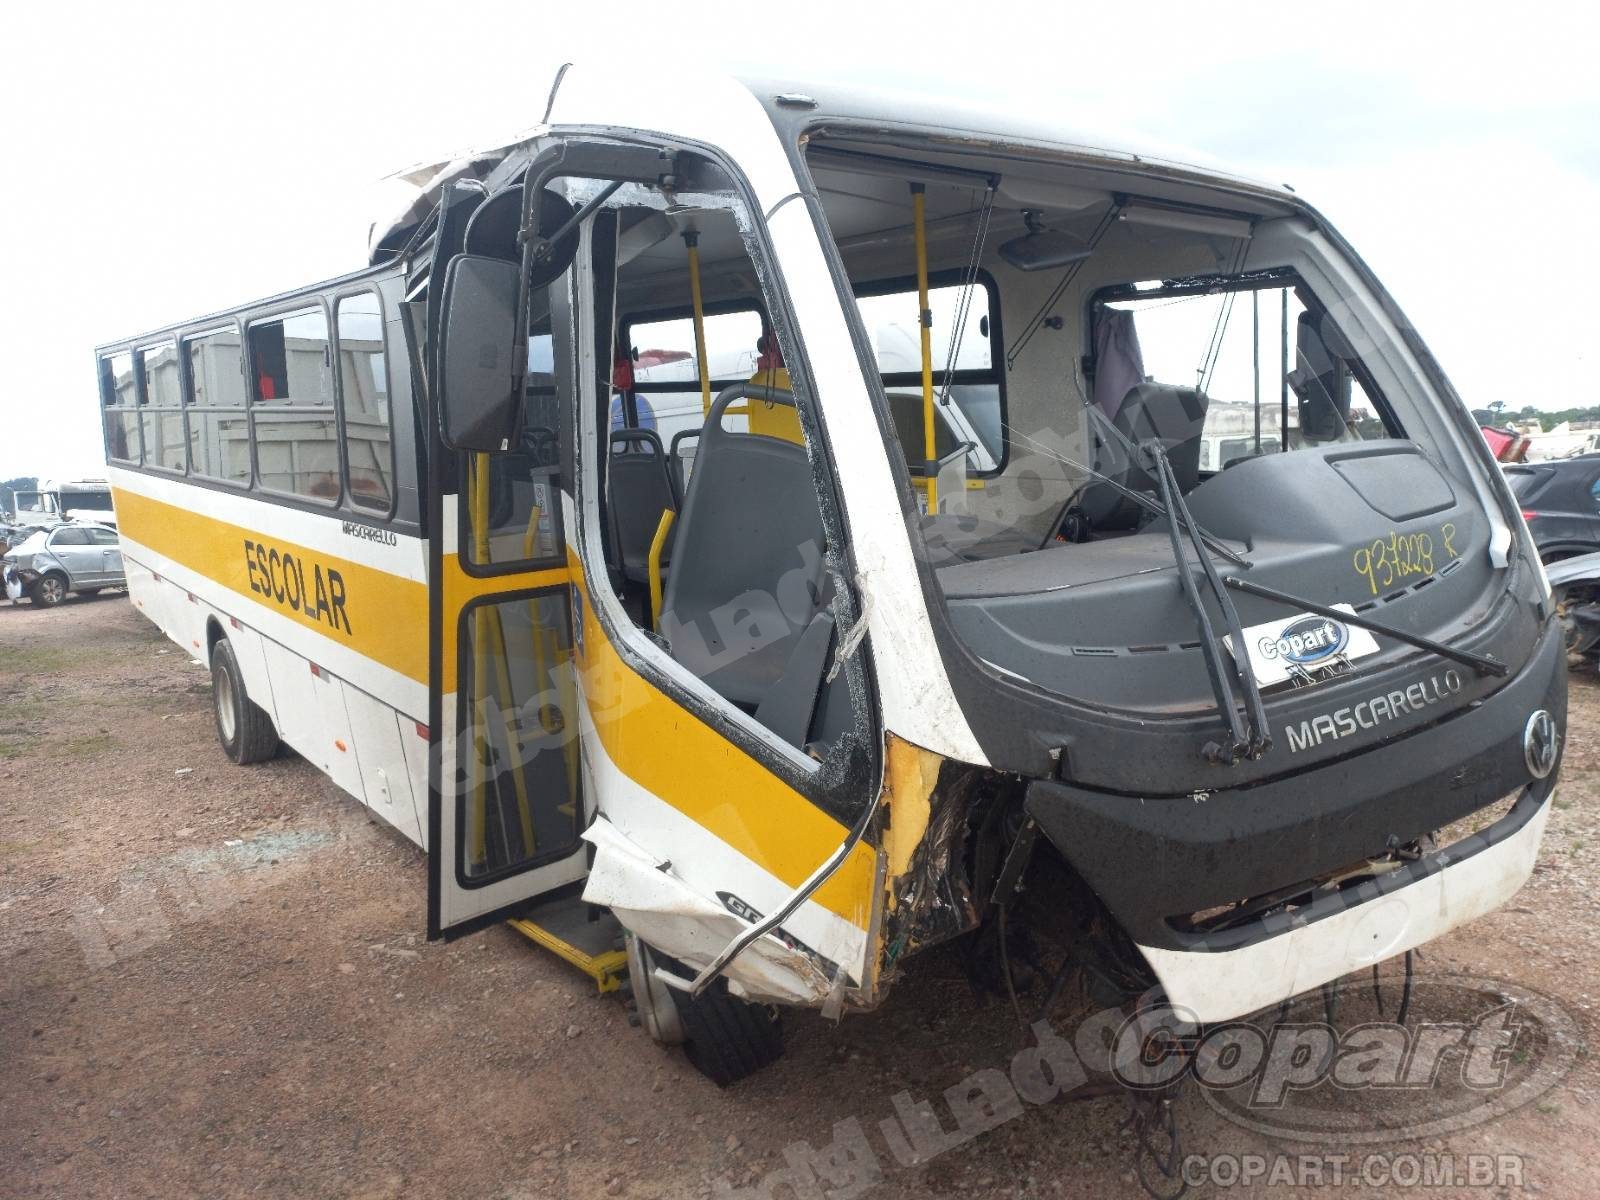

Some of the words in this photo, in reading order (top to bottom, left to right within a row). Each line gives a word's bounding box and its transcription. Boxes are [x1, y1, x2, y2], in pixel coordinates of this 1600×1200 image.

[342, 520, 397, 546] MASCARELLO
[244, 539, 352, 636] ESCOLAR
[1258, 620, 1339, 660] Copart
[1284, 670, 1462, 753] MASCARELLO
